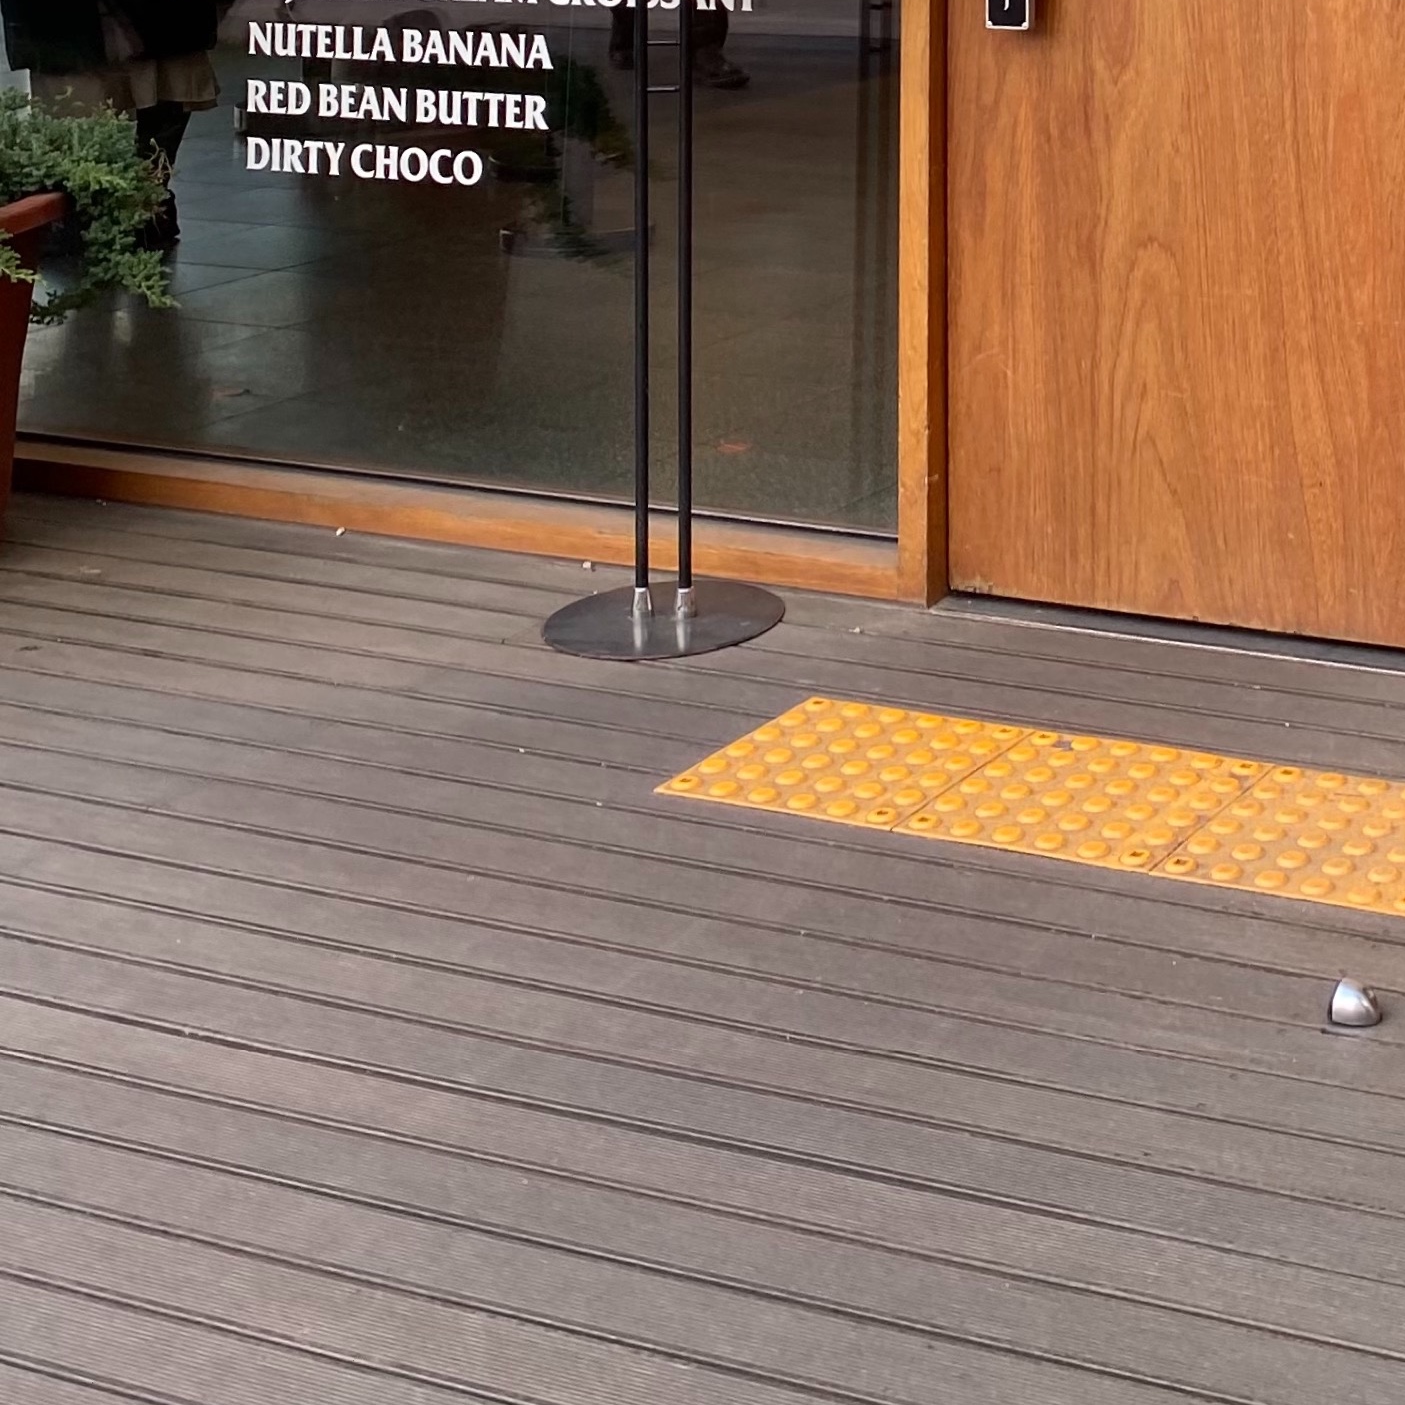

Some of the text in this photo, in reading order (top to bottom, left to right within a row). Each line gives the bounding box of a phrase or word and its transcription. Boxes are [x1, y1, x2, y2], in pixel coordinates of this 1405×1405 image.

[247, 21, 554, 70] NUTELLA BANANA
[245, 79, 550, 131] RED BEAN BUTTER
[245, 136, 484, 187] DIRTY CHOCO
